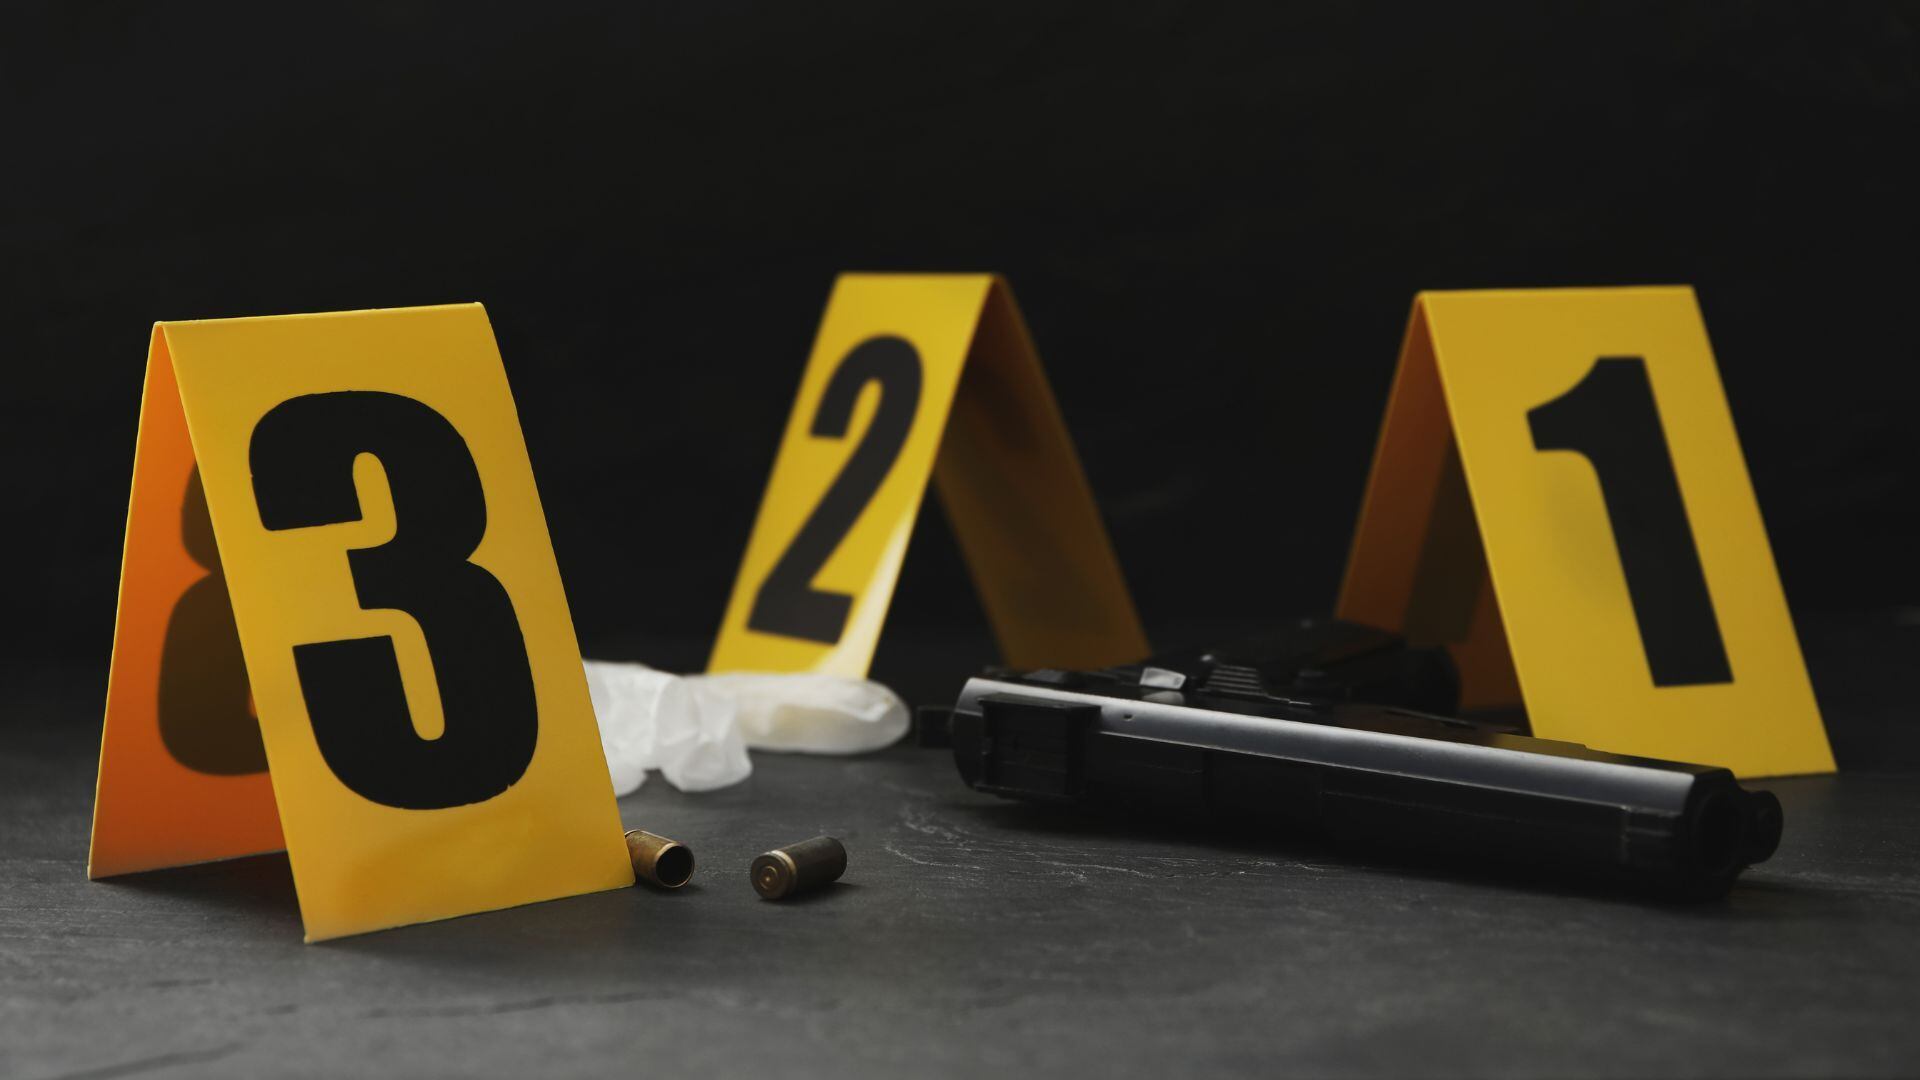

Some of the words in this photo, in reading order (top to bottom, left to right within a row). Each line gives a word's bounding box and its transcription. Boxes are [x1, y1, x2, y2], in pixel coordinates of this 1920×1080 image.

[249, 391, 538, 810] 3
[747, 336, 922, 645] 2
[1526, 357, 1734, 688] 1
